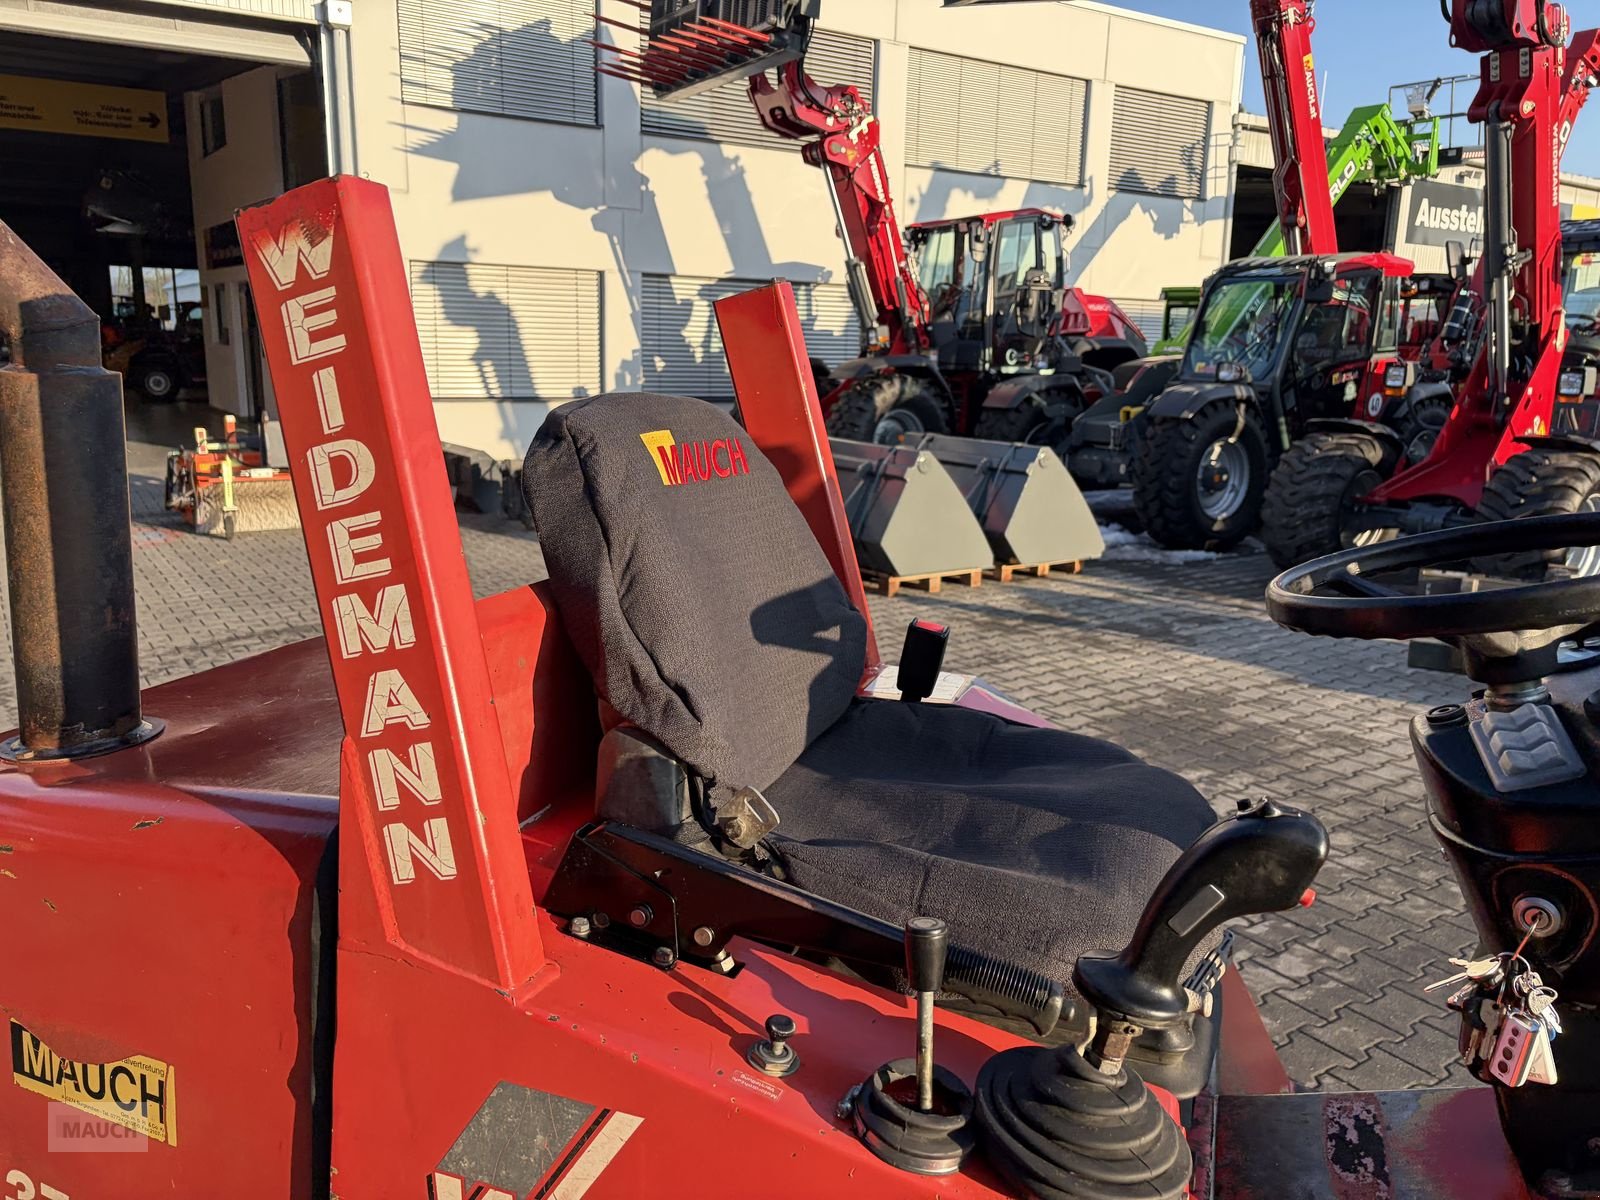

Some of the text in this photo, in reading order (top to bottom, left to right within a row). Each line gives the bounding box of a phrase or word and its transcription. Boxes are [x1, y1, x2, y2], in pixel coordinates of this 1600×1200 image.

[1303, 59, 1317, 120] MAUCH.at
[657, 437, 751, 486] MAUCH
[252, 226, 458, 885] WEIDEMANN
[21, 1029, 165, 1124] MAUCH
